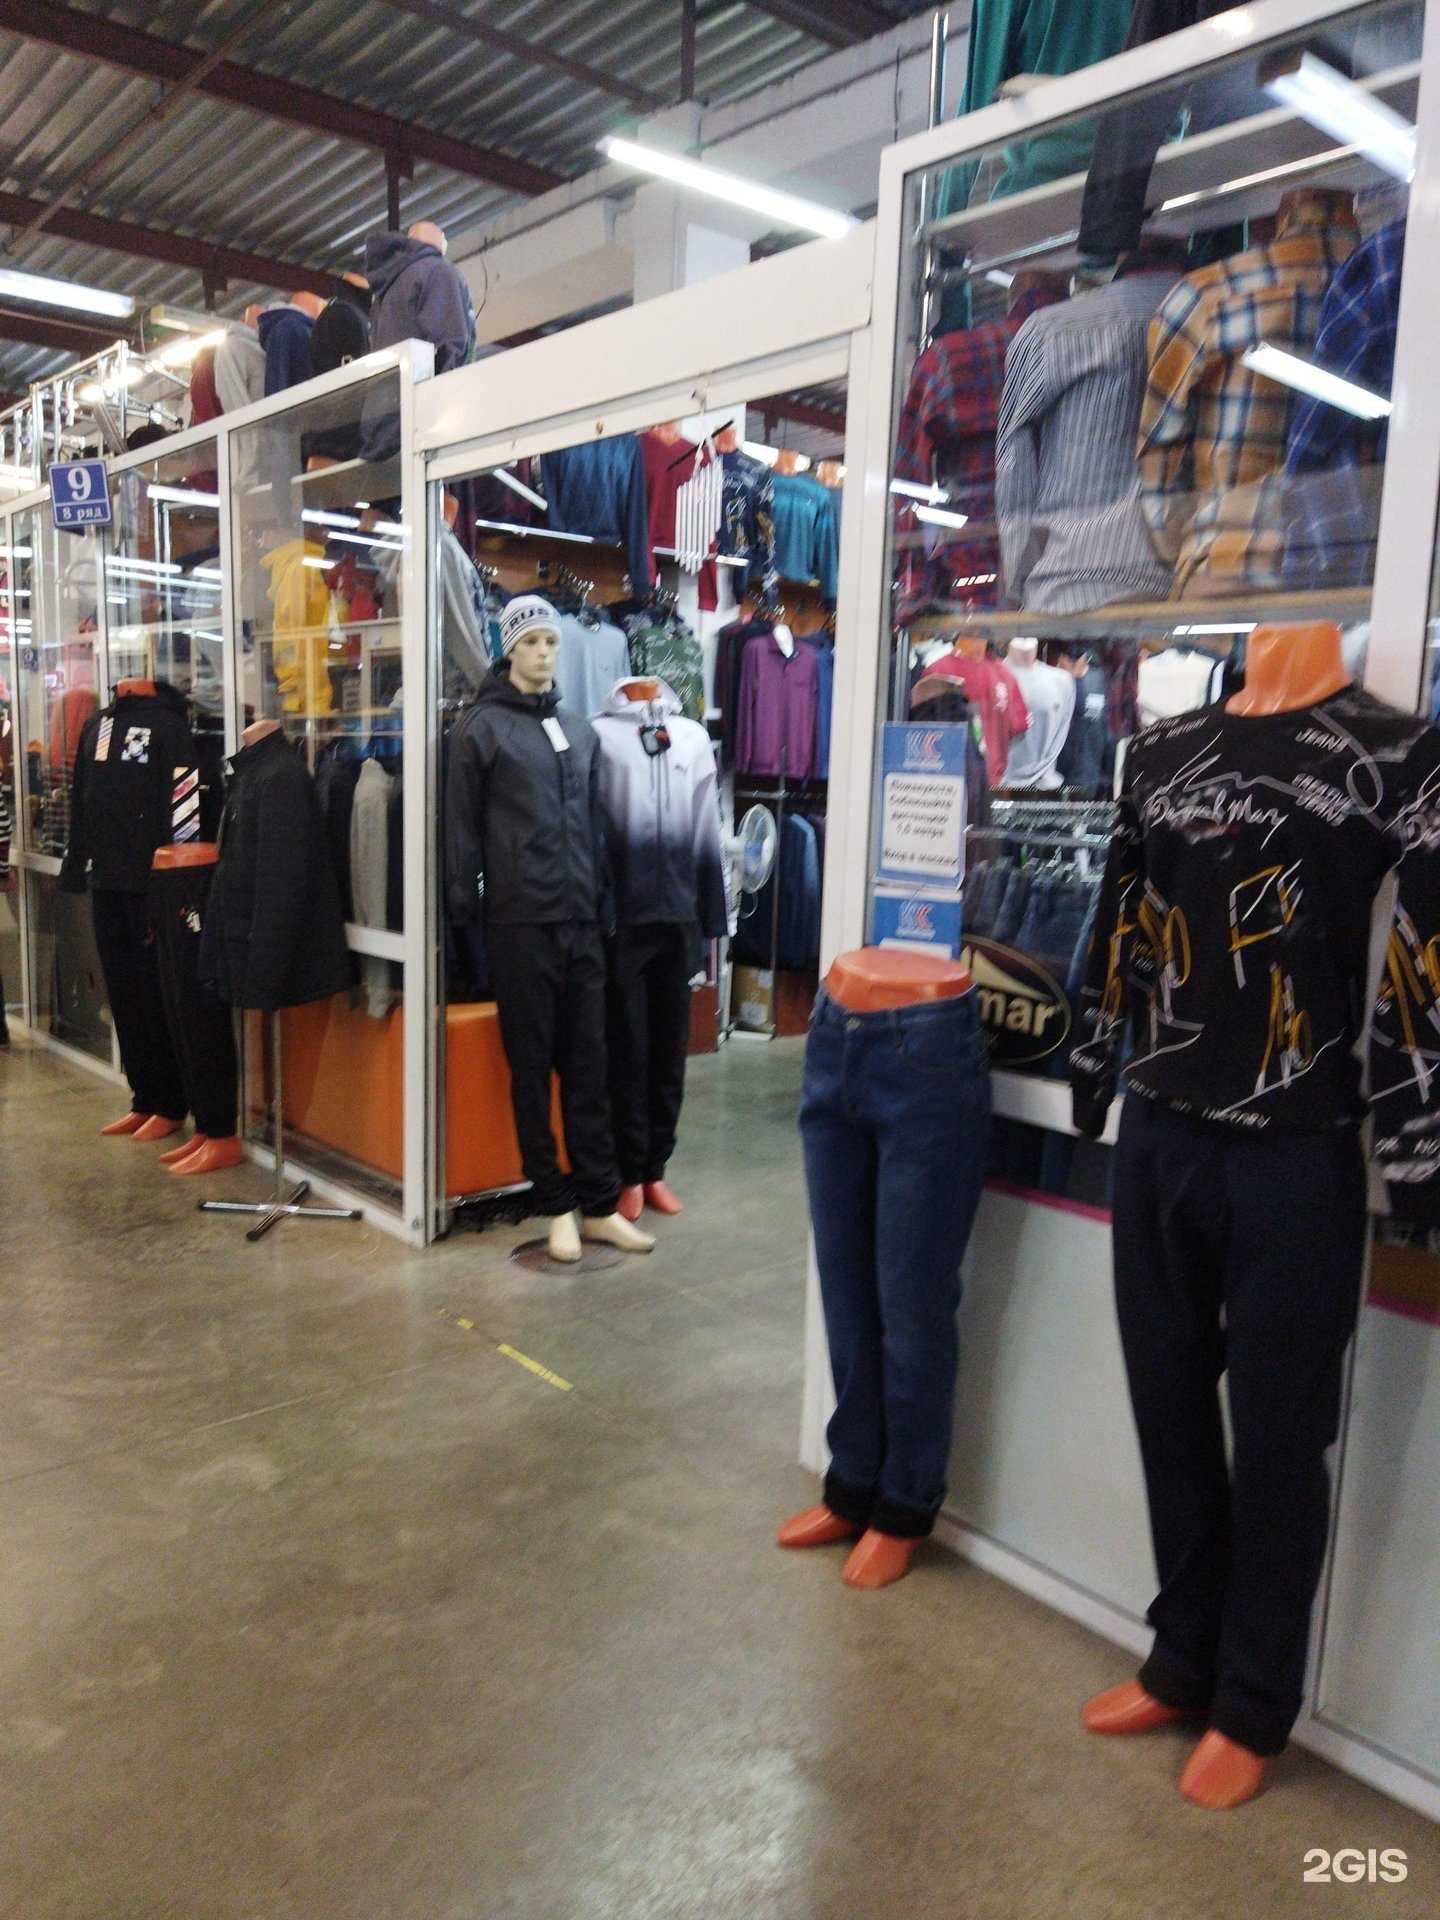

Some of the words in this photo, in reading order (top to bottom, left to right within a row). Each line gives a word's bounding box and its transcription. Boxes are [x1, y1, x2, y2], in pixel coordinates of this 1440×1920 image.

[67, 467, 92, 501] 9
[62, 506, 72, 520] 8
[77, 506, 103, 522] ряд
